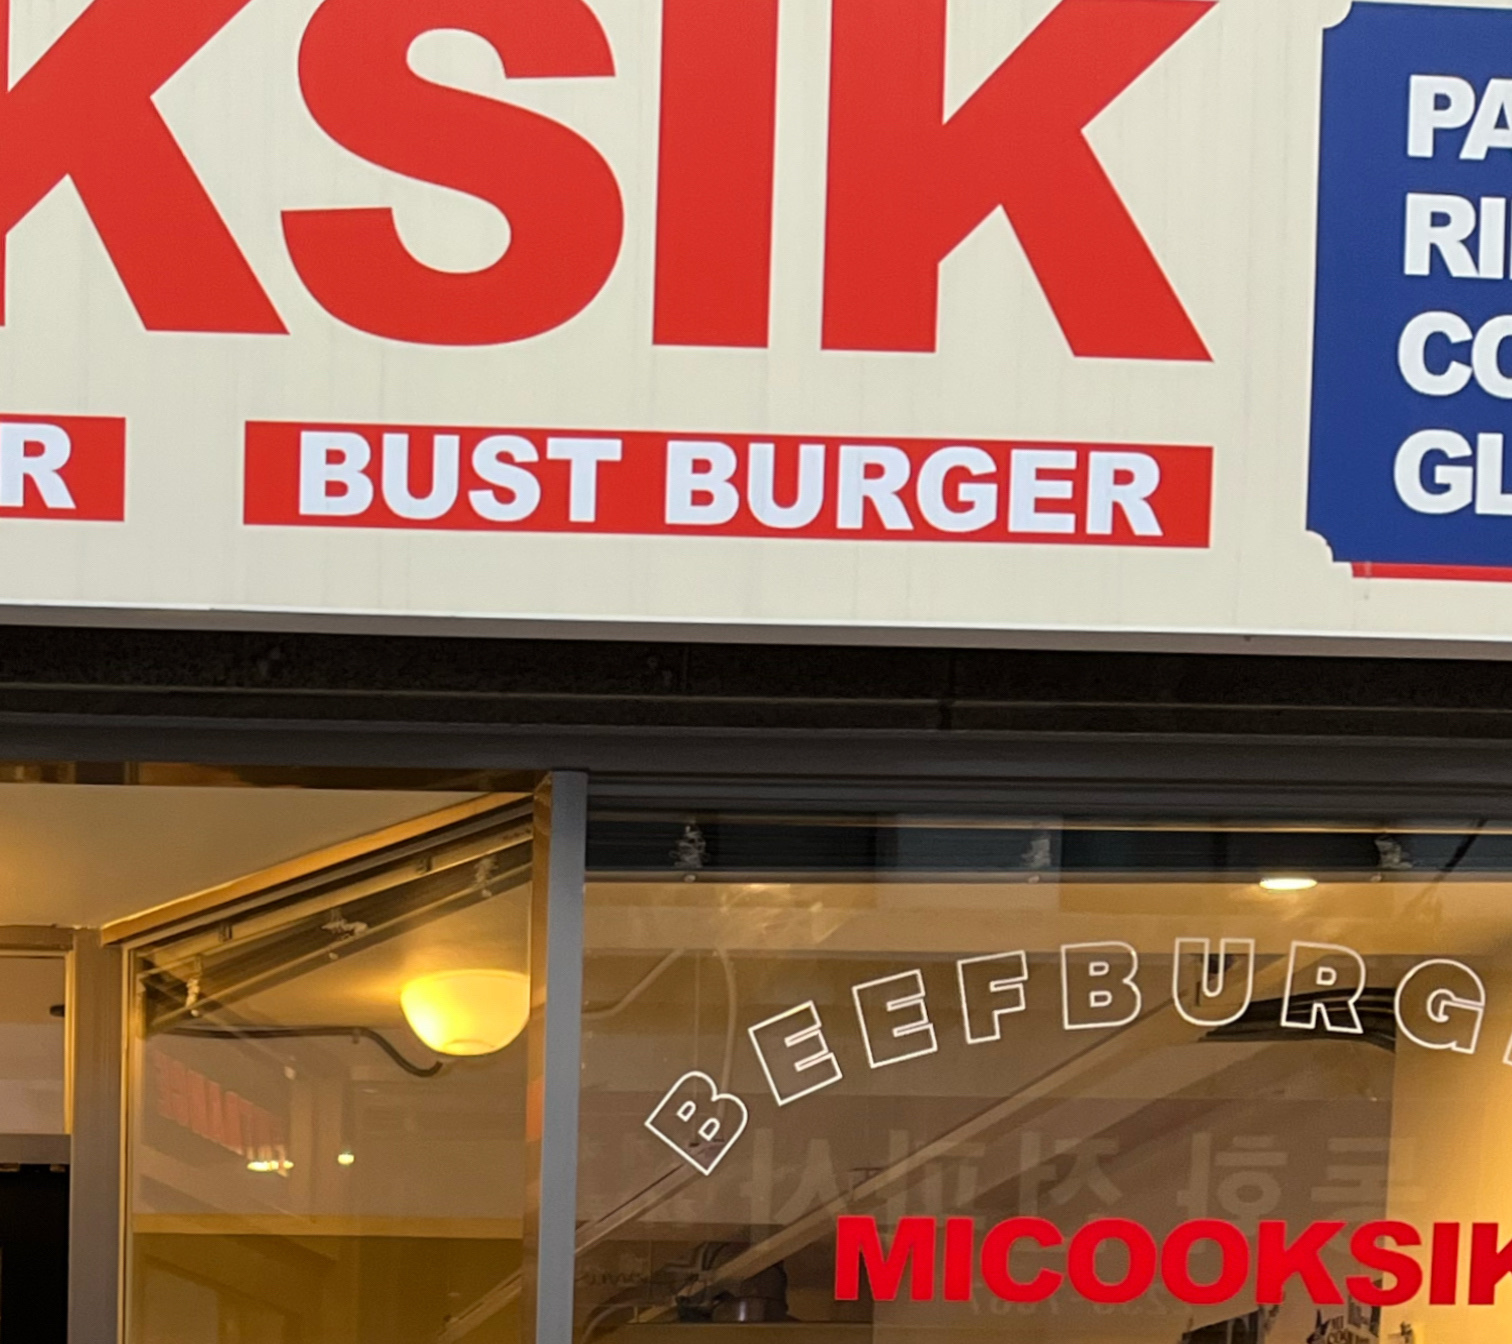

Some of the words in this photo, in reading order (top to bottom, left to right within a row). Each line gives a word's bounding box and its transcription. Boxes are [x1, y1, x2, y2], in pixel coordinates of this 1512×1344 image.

[1404, 192, 1512, 280] RI
[299, 430, 622, 522] BUST
[664, 440, 1162, 536] BURGER
[645, 938, 1512, 1175] BEEFBURG
[834, 1215, 1512, 1306] MICOOKSIK
